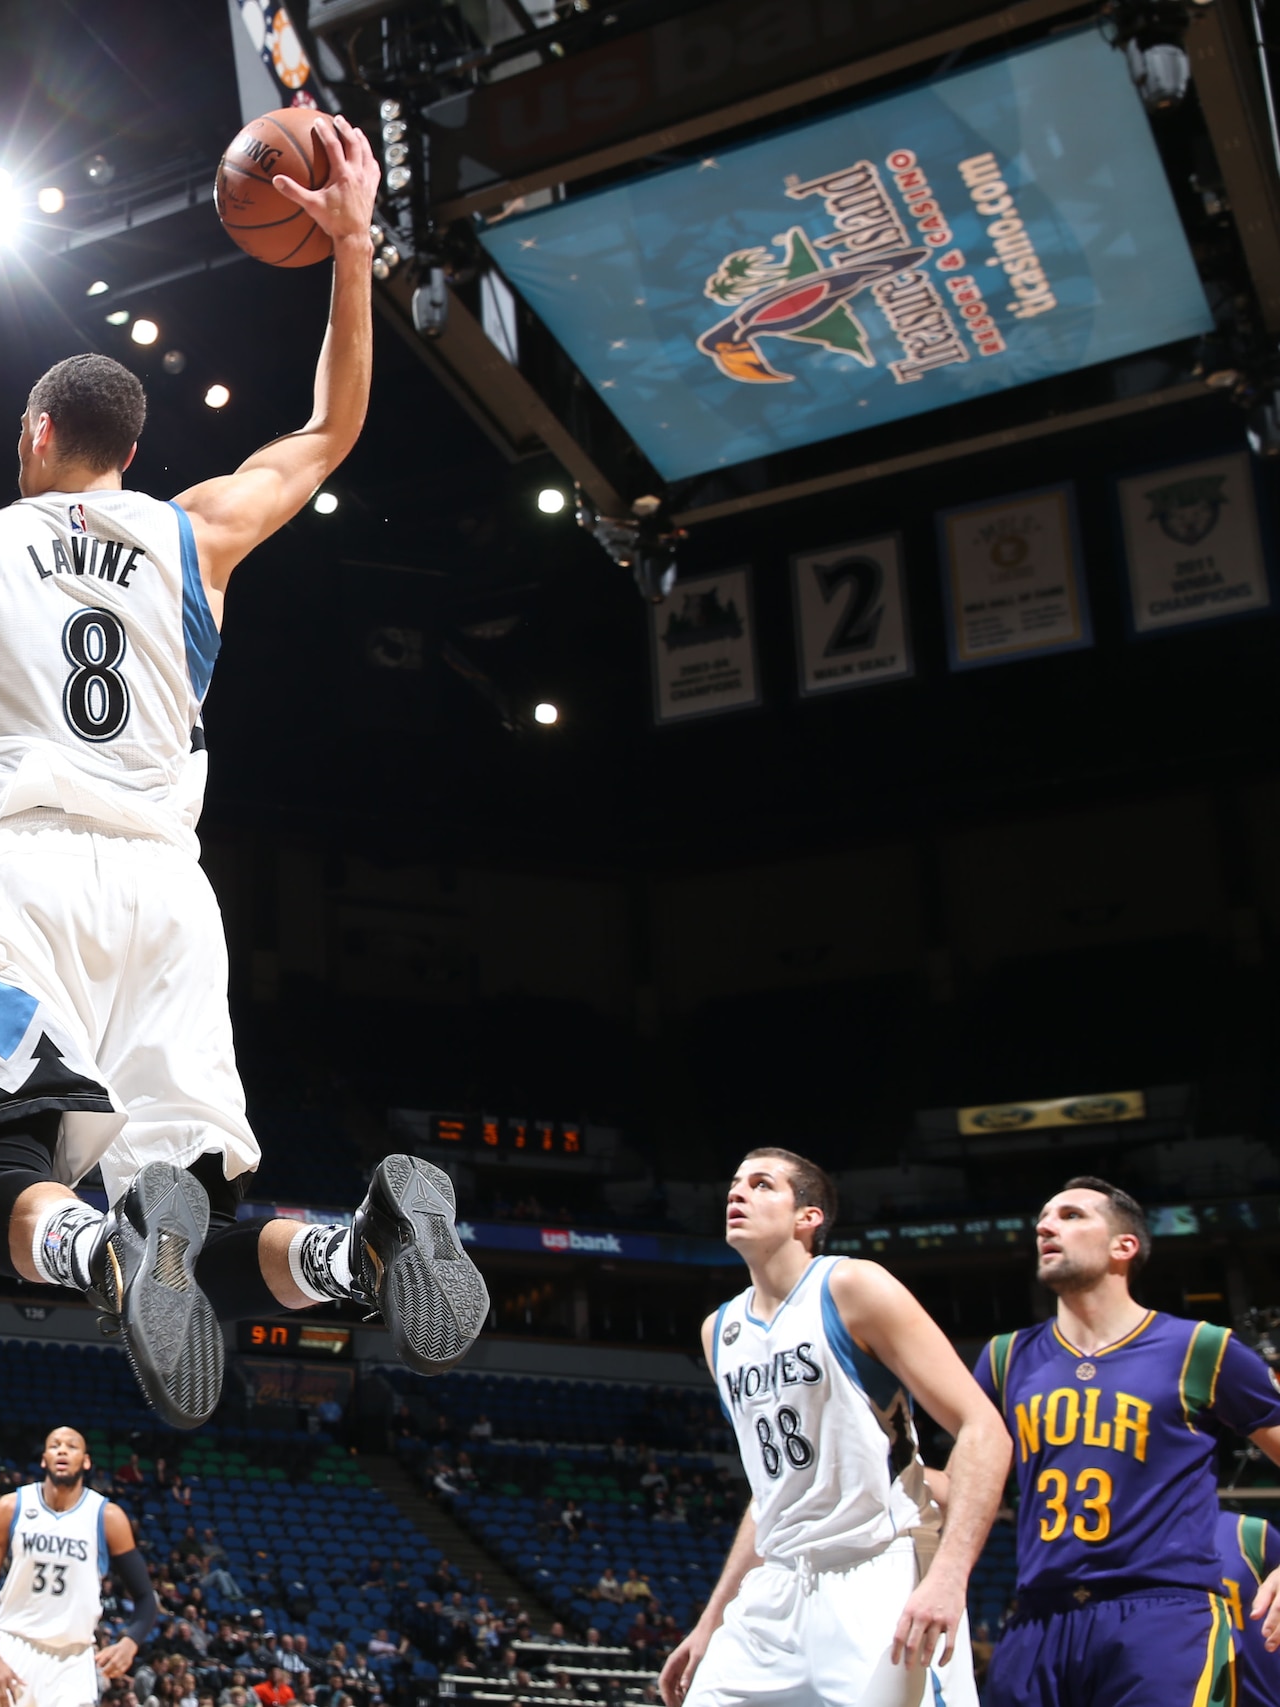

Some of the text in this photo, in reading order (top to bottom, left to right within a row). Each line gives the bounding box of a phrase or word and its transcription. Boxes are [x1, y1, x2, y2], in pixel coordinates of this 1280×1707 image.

[785, 160, 969, 384] Treasure Island
[886, 149, 1007, 356] RESORT & CASINO
[958, 152, 1057, 319] ticasino.com
[27, 536, 146, 588] LAVINE
[812, 555, 885, 657] 2
[62, 607, 130, 742] 8
[723, 1342, 823, 1414] WOLVES
[755, 1405, 815, 1478] 88
[1014, 1387, 1153, 1463] NOLA
[1036, 1468, 1113, 1542] 33
[21, 1532, 90, 1562] WOLVES
[32, 1562, 68, 1596] 33
